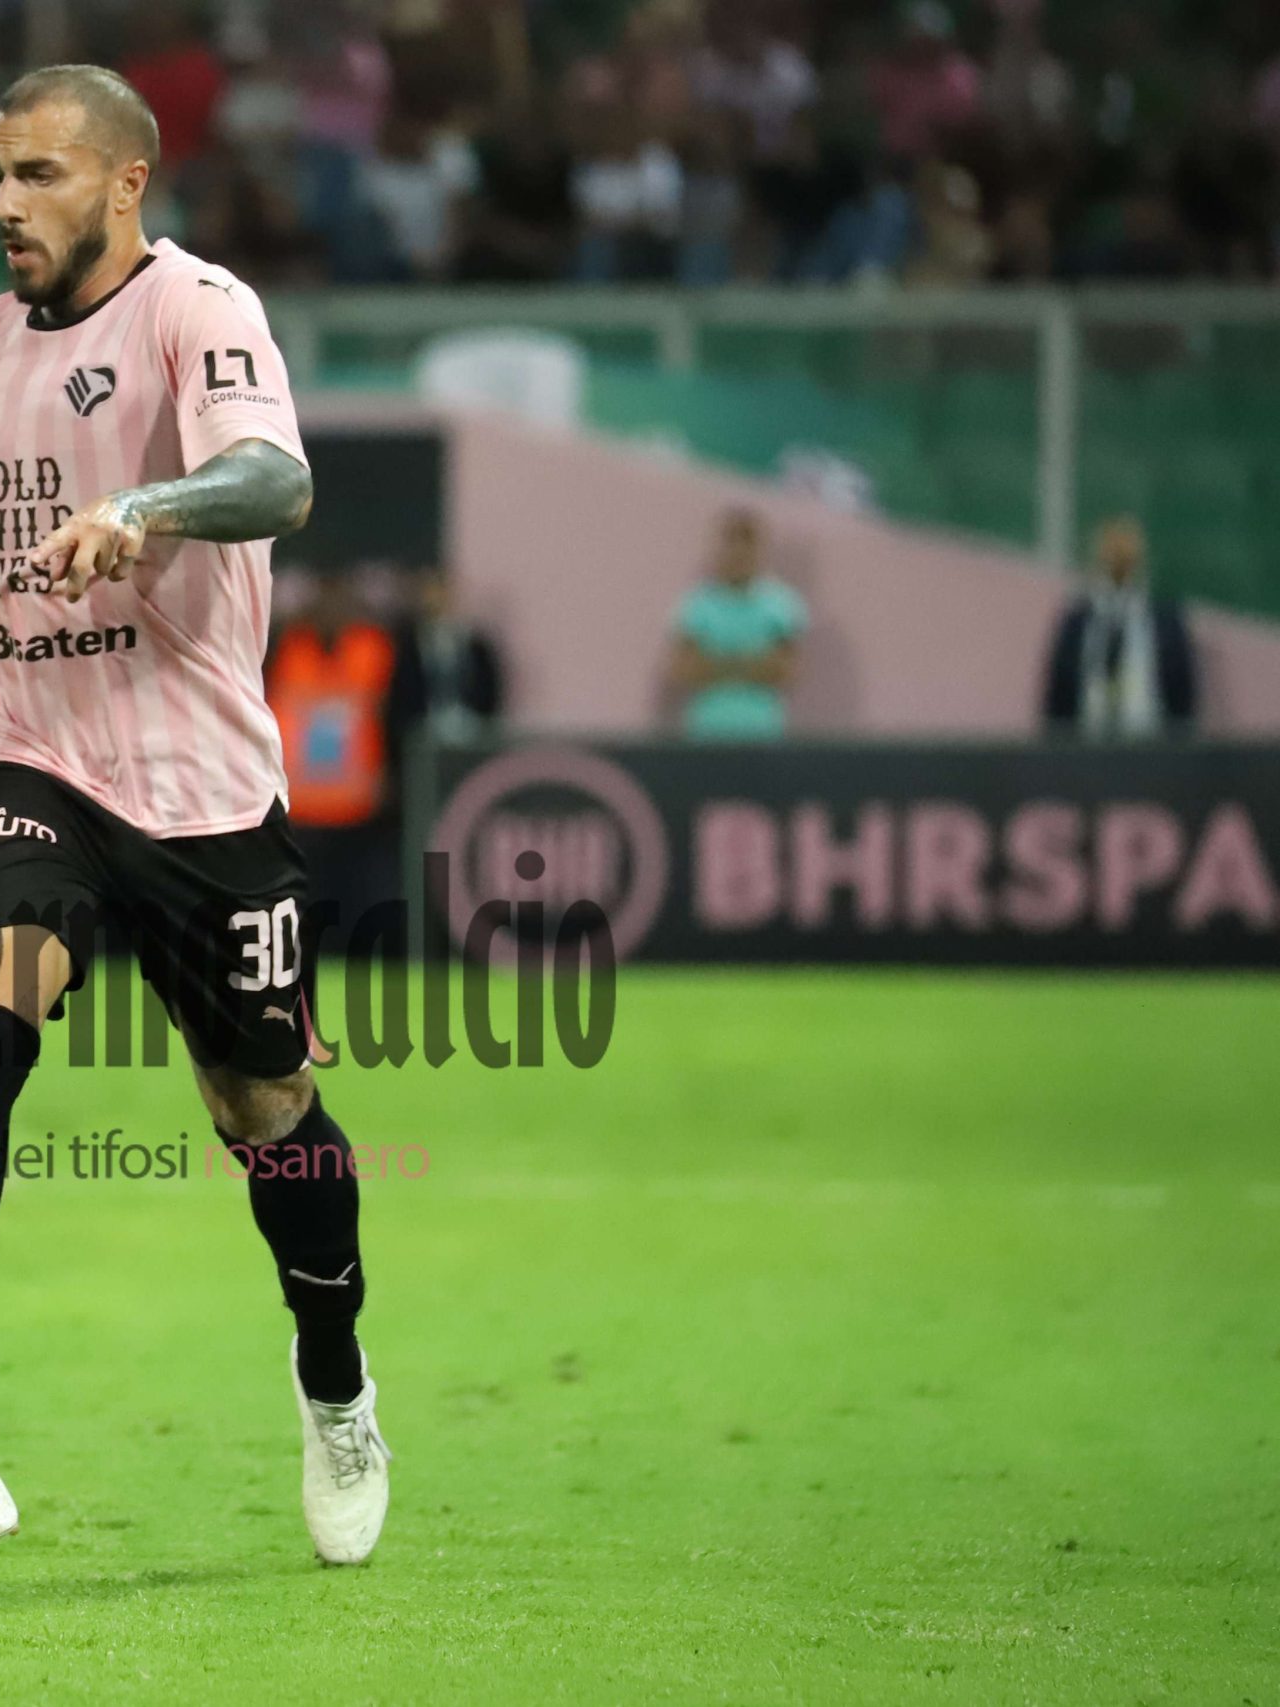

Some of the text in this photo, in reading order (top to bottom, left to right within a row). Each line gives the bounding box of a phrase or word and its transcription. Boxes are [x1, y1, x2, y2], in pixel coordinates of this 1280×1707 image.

[210, 391, 280, 406] Costruzioni
[694, 802, 1279, 932] BHRSPA
[227, 896, 302, 992] 30
